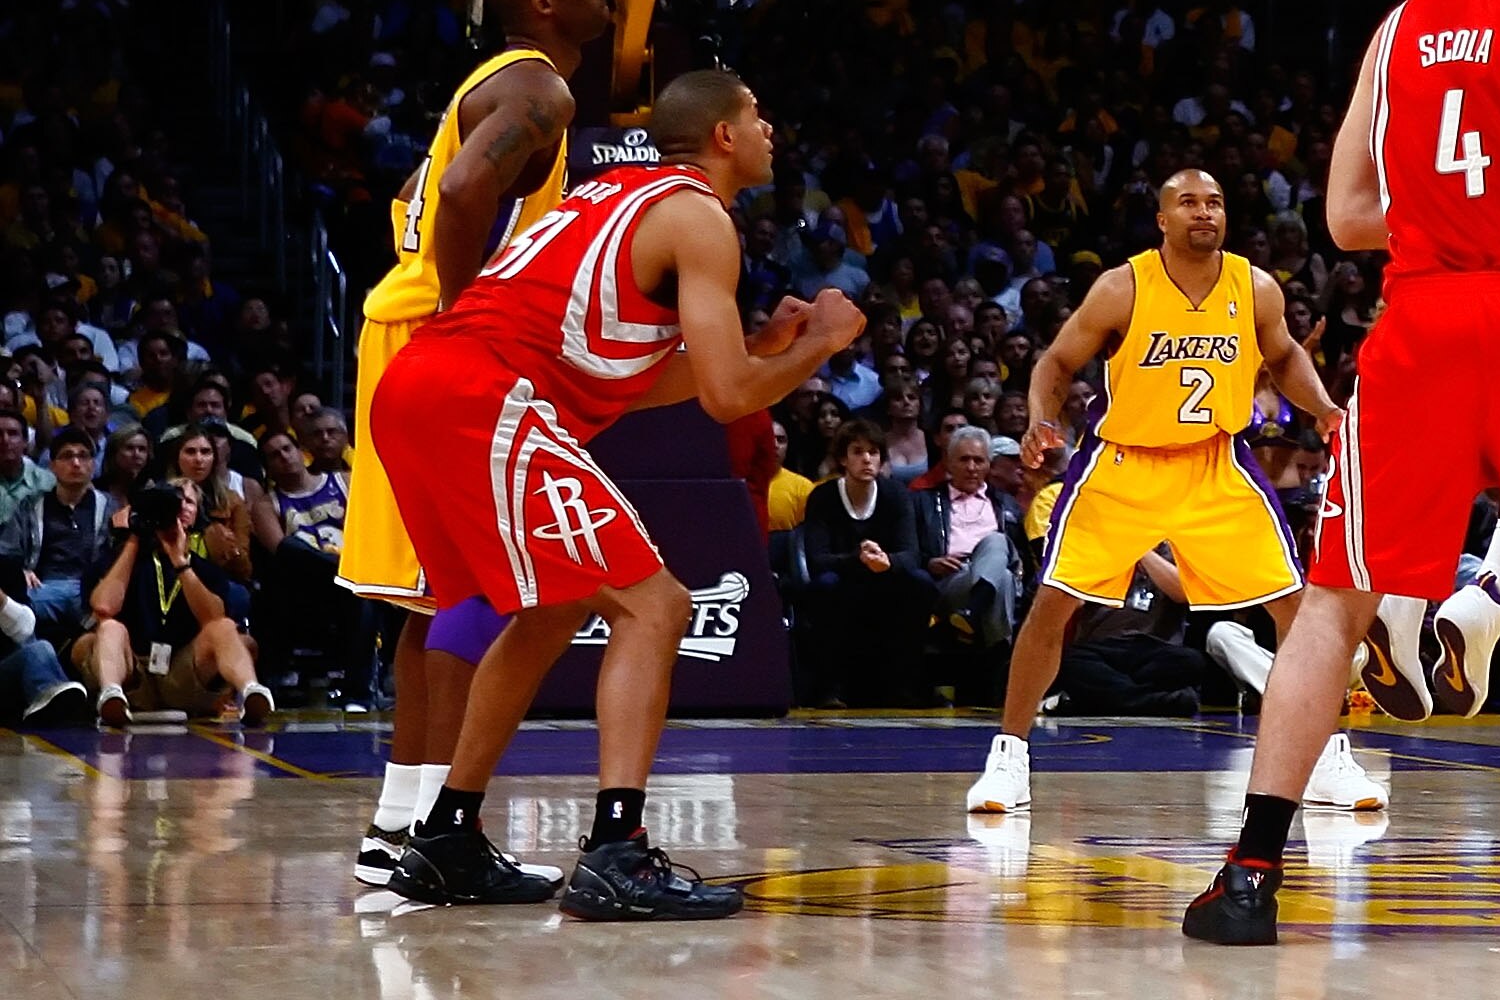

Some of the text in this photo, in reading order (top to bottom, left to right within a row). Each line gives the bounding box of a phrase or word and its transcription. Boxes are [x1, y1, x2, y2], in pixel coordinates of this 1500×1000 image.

[1418, 28, 1494, 69] SCOLA
[592, 144, 662, 165] SPALDI
[1435, 87, 1492, 199] 4
[1137, 331, 1240, 369] LAKERS
[1177, 365, 1215, 424] 2
